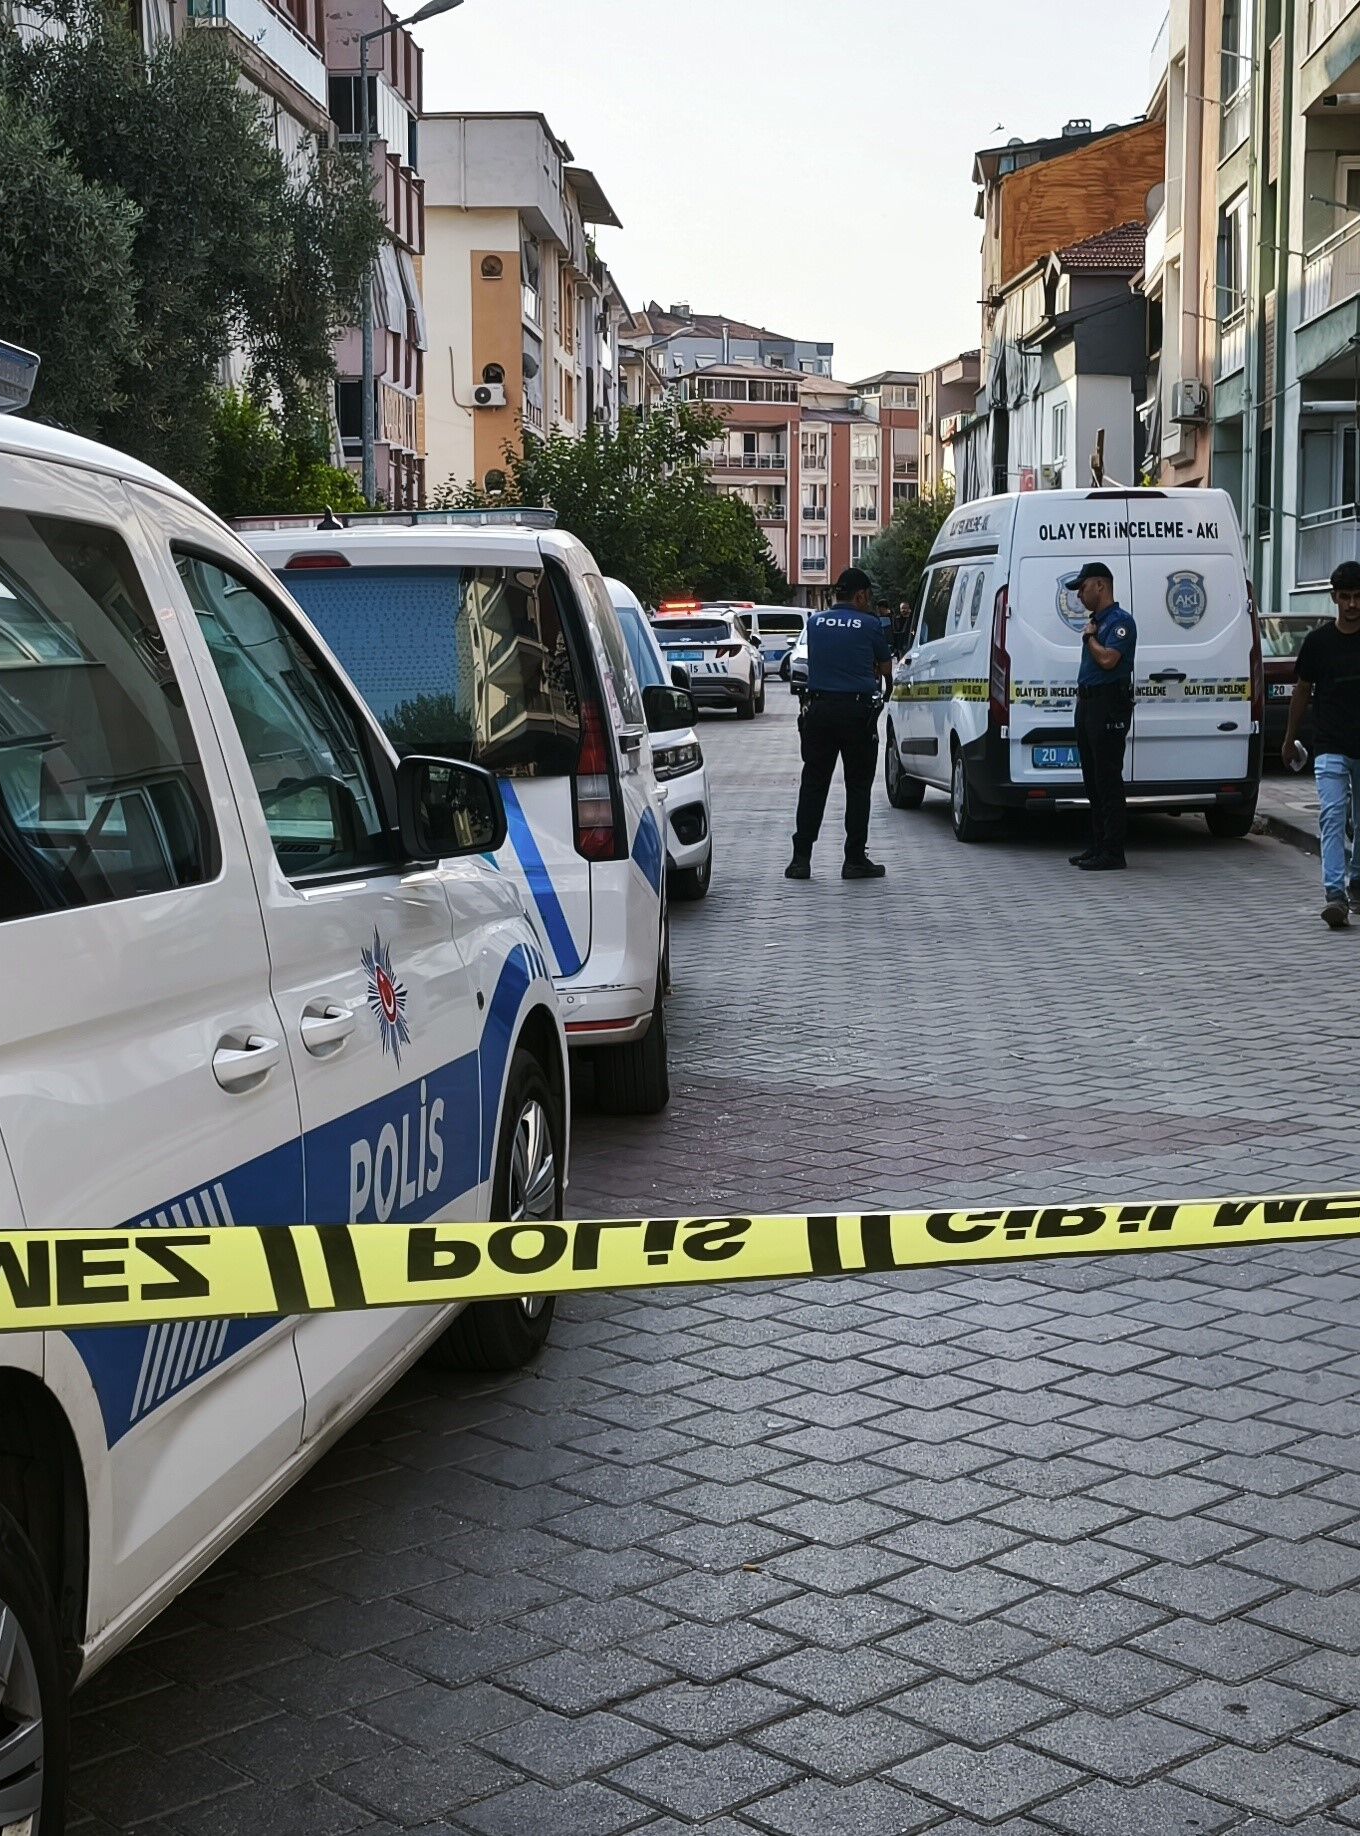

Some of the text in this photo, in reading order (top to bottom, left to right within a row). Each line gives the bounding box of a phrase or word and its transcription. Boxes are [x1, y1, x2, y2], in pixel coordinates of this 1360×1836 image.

[1039, 523, 1076, 541] OLAY
[1079, 522, 1111, 539] YERİ
[1114, 521, 1183, 539] İNCELEME
[1274, 685, 1285, 696] 20
[1042, 748, 1074, 762] 20 A
[349, 1078, 445, 1224] POLİS
